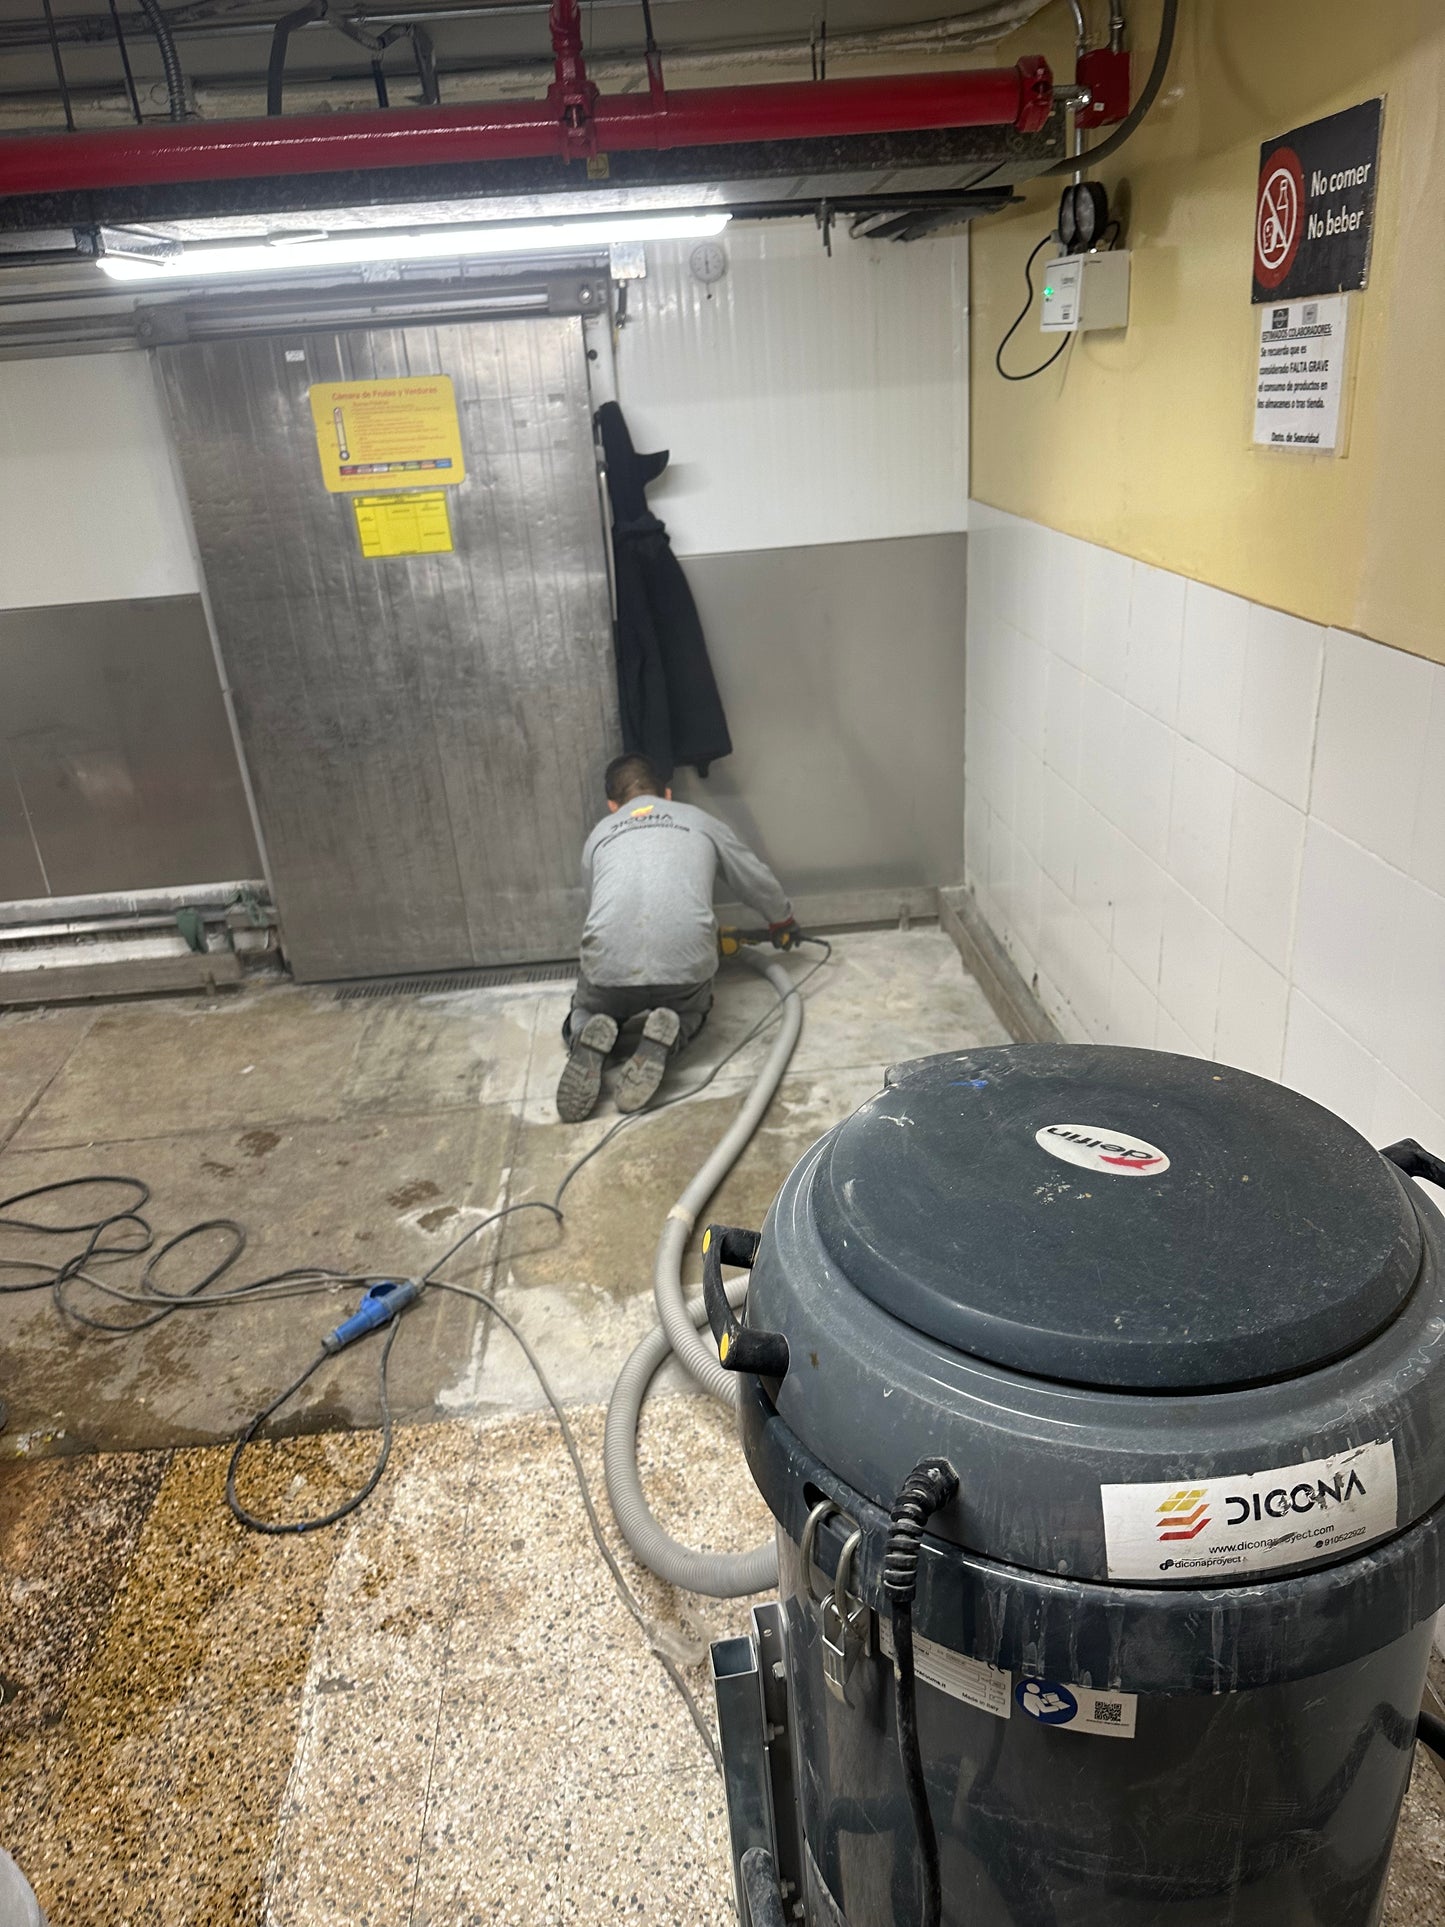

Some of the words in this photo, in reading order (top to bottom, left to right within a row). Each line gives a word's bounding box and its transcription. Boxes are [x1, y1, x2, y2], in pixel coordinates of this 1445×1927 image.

[1310, 170, 1328, 197] No
[1329, 163, 1372, 192] comer
[1307, 213, 1324, 240] No
[1326, 205, 1364, 236] beber
[1260, 347, 1267, 357] Se
[1268, 345, 1289, 356] recuerda
[1290, 345, 1300, 356] que
[1301, 345, 1307, 354] es
[1290, 361, 1308, 373] FALTA
[1308, 359, 1329, 372] GRAVE
[1047, 1127, 1153, 1159] delfin
[1225, 1469, 1366, 1526] DICONA
[1208, 1524, 1334, 1554] www.diconaoyect.com
[1175, 1556, 1241, 1569] diconaproyect
